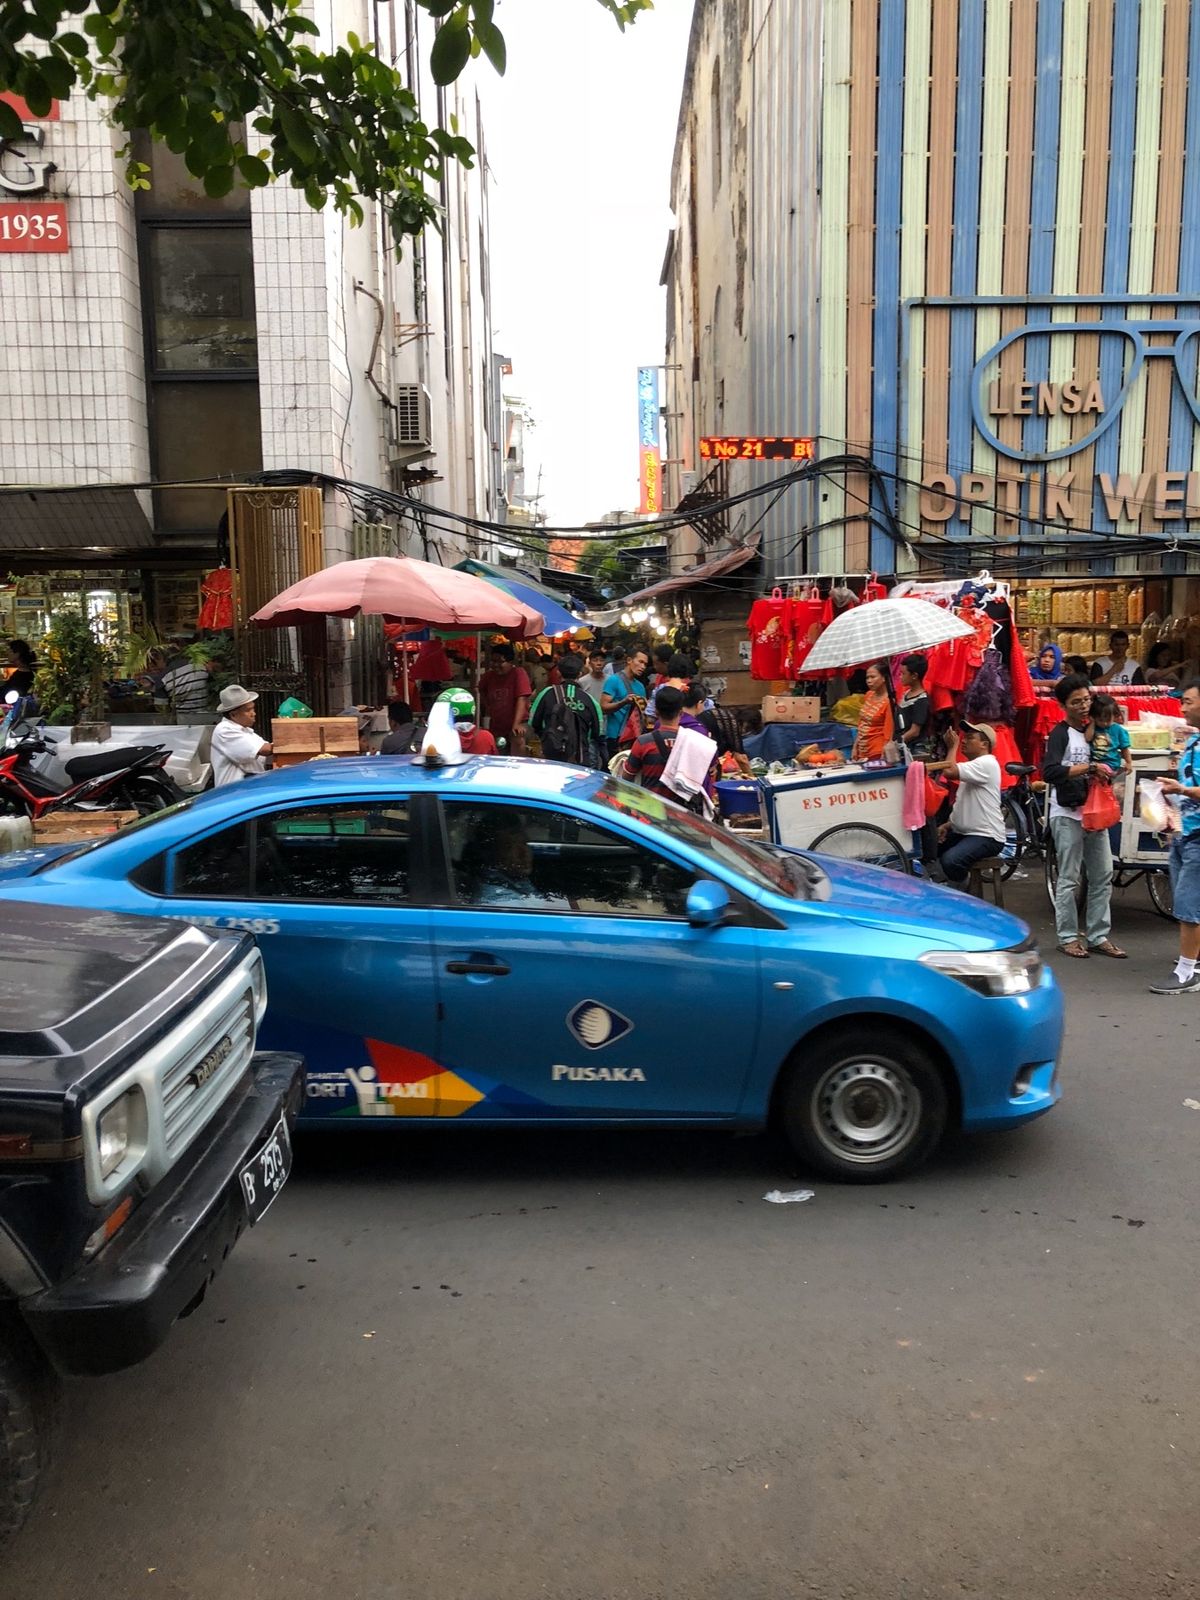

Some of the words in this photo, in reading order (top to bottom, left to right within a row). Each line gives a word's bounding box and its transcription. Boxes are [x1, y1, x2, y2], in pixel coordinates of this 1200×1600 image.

[0, 214, 62, 240] 1935
[989, 380, 1106, 416] LENSA
[714, 442, 738, 456] No
[742, 442, 762, 456] 21
[920, 472, 1076, 522] OPTIK
[802, 797, 823, 810] ES
[828, 787, 889, 807] POTONG
[551, 1064, 647, 1081] PUSAKA
[378, 1082, 429, 1098] TAXI
[243, 1172, 256, 1205] B
[260, 1136, 283, 1188] 2575
